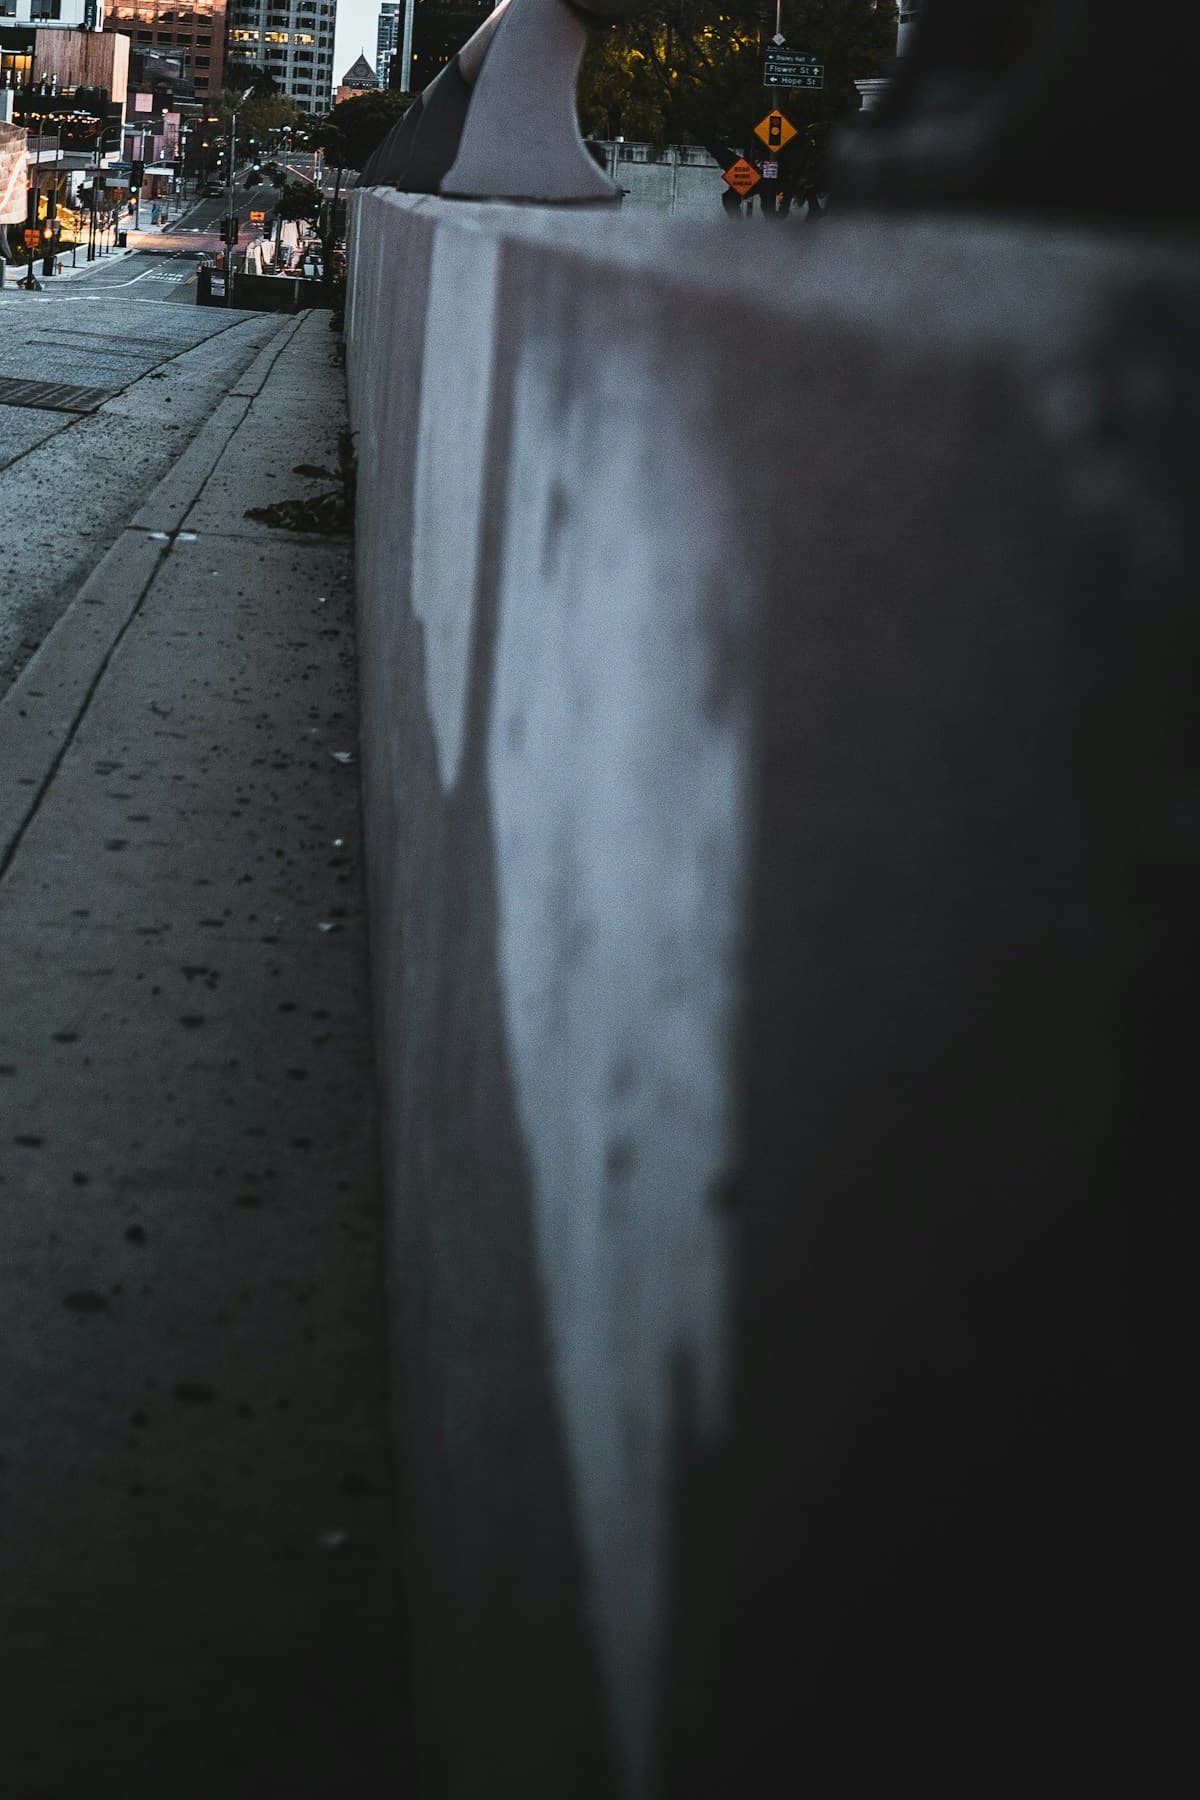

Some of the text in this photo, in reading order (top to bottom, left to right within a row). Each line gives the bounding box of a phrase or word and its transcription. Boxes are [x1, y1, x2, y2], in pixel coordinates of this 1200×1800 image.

[769, 64, 810, 74] Flower St
[781, 77, 816, 86] Hope St
